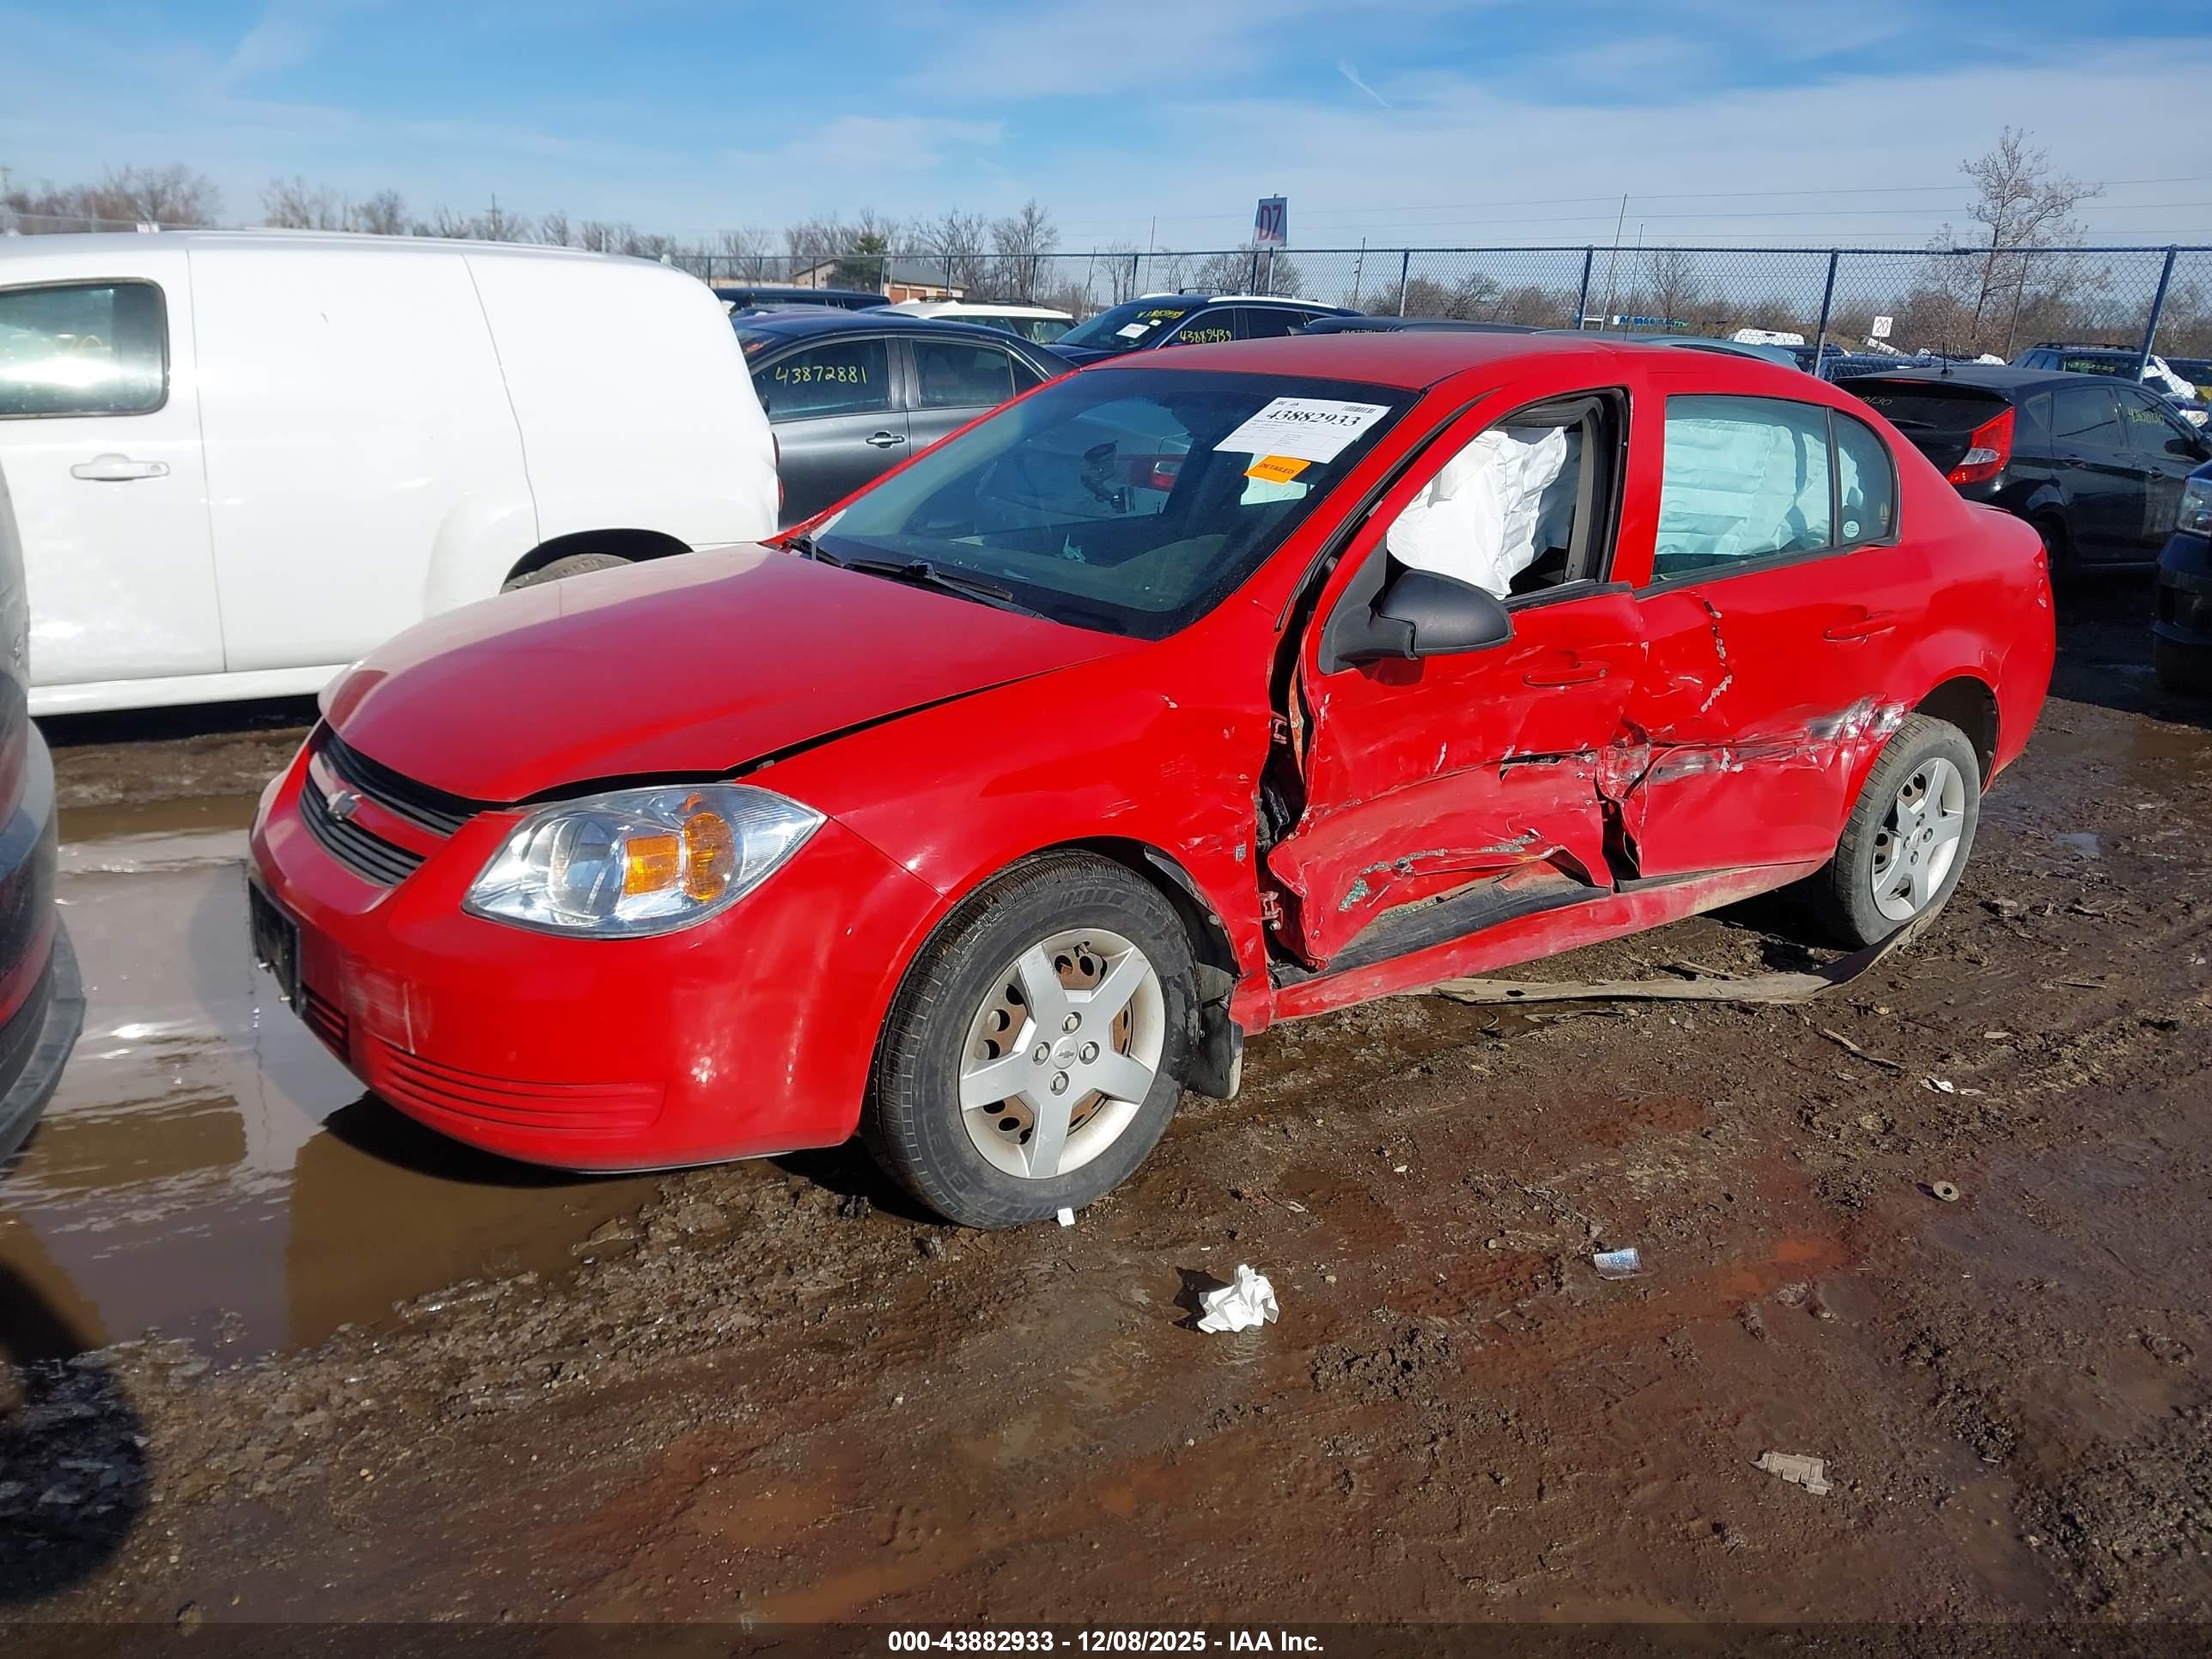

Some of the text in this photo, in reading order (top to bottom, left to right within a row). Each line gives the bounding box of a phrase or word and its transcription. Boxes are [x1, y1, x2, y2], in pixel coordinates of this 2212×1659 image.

[1875, 319, 1889, 334] 20
[1180, 328, 1232, 343] 43889439
[775, 366, 866, 387] 43872881
[1266, 410, 1362, 427] 43882933
[1258, 463, 1295, 475] DETAILED
